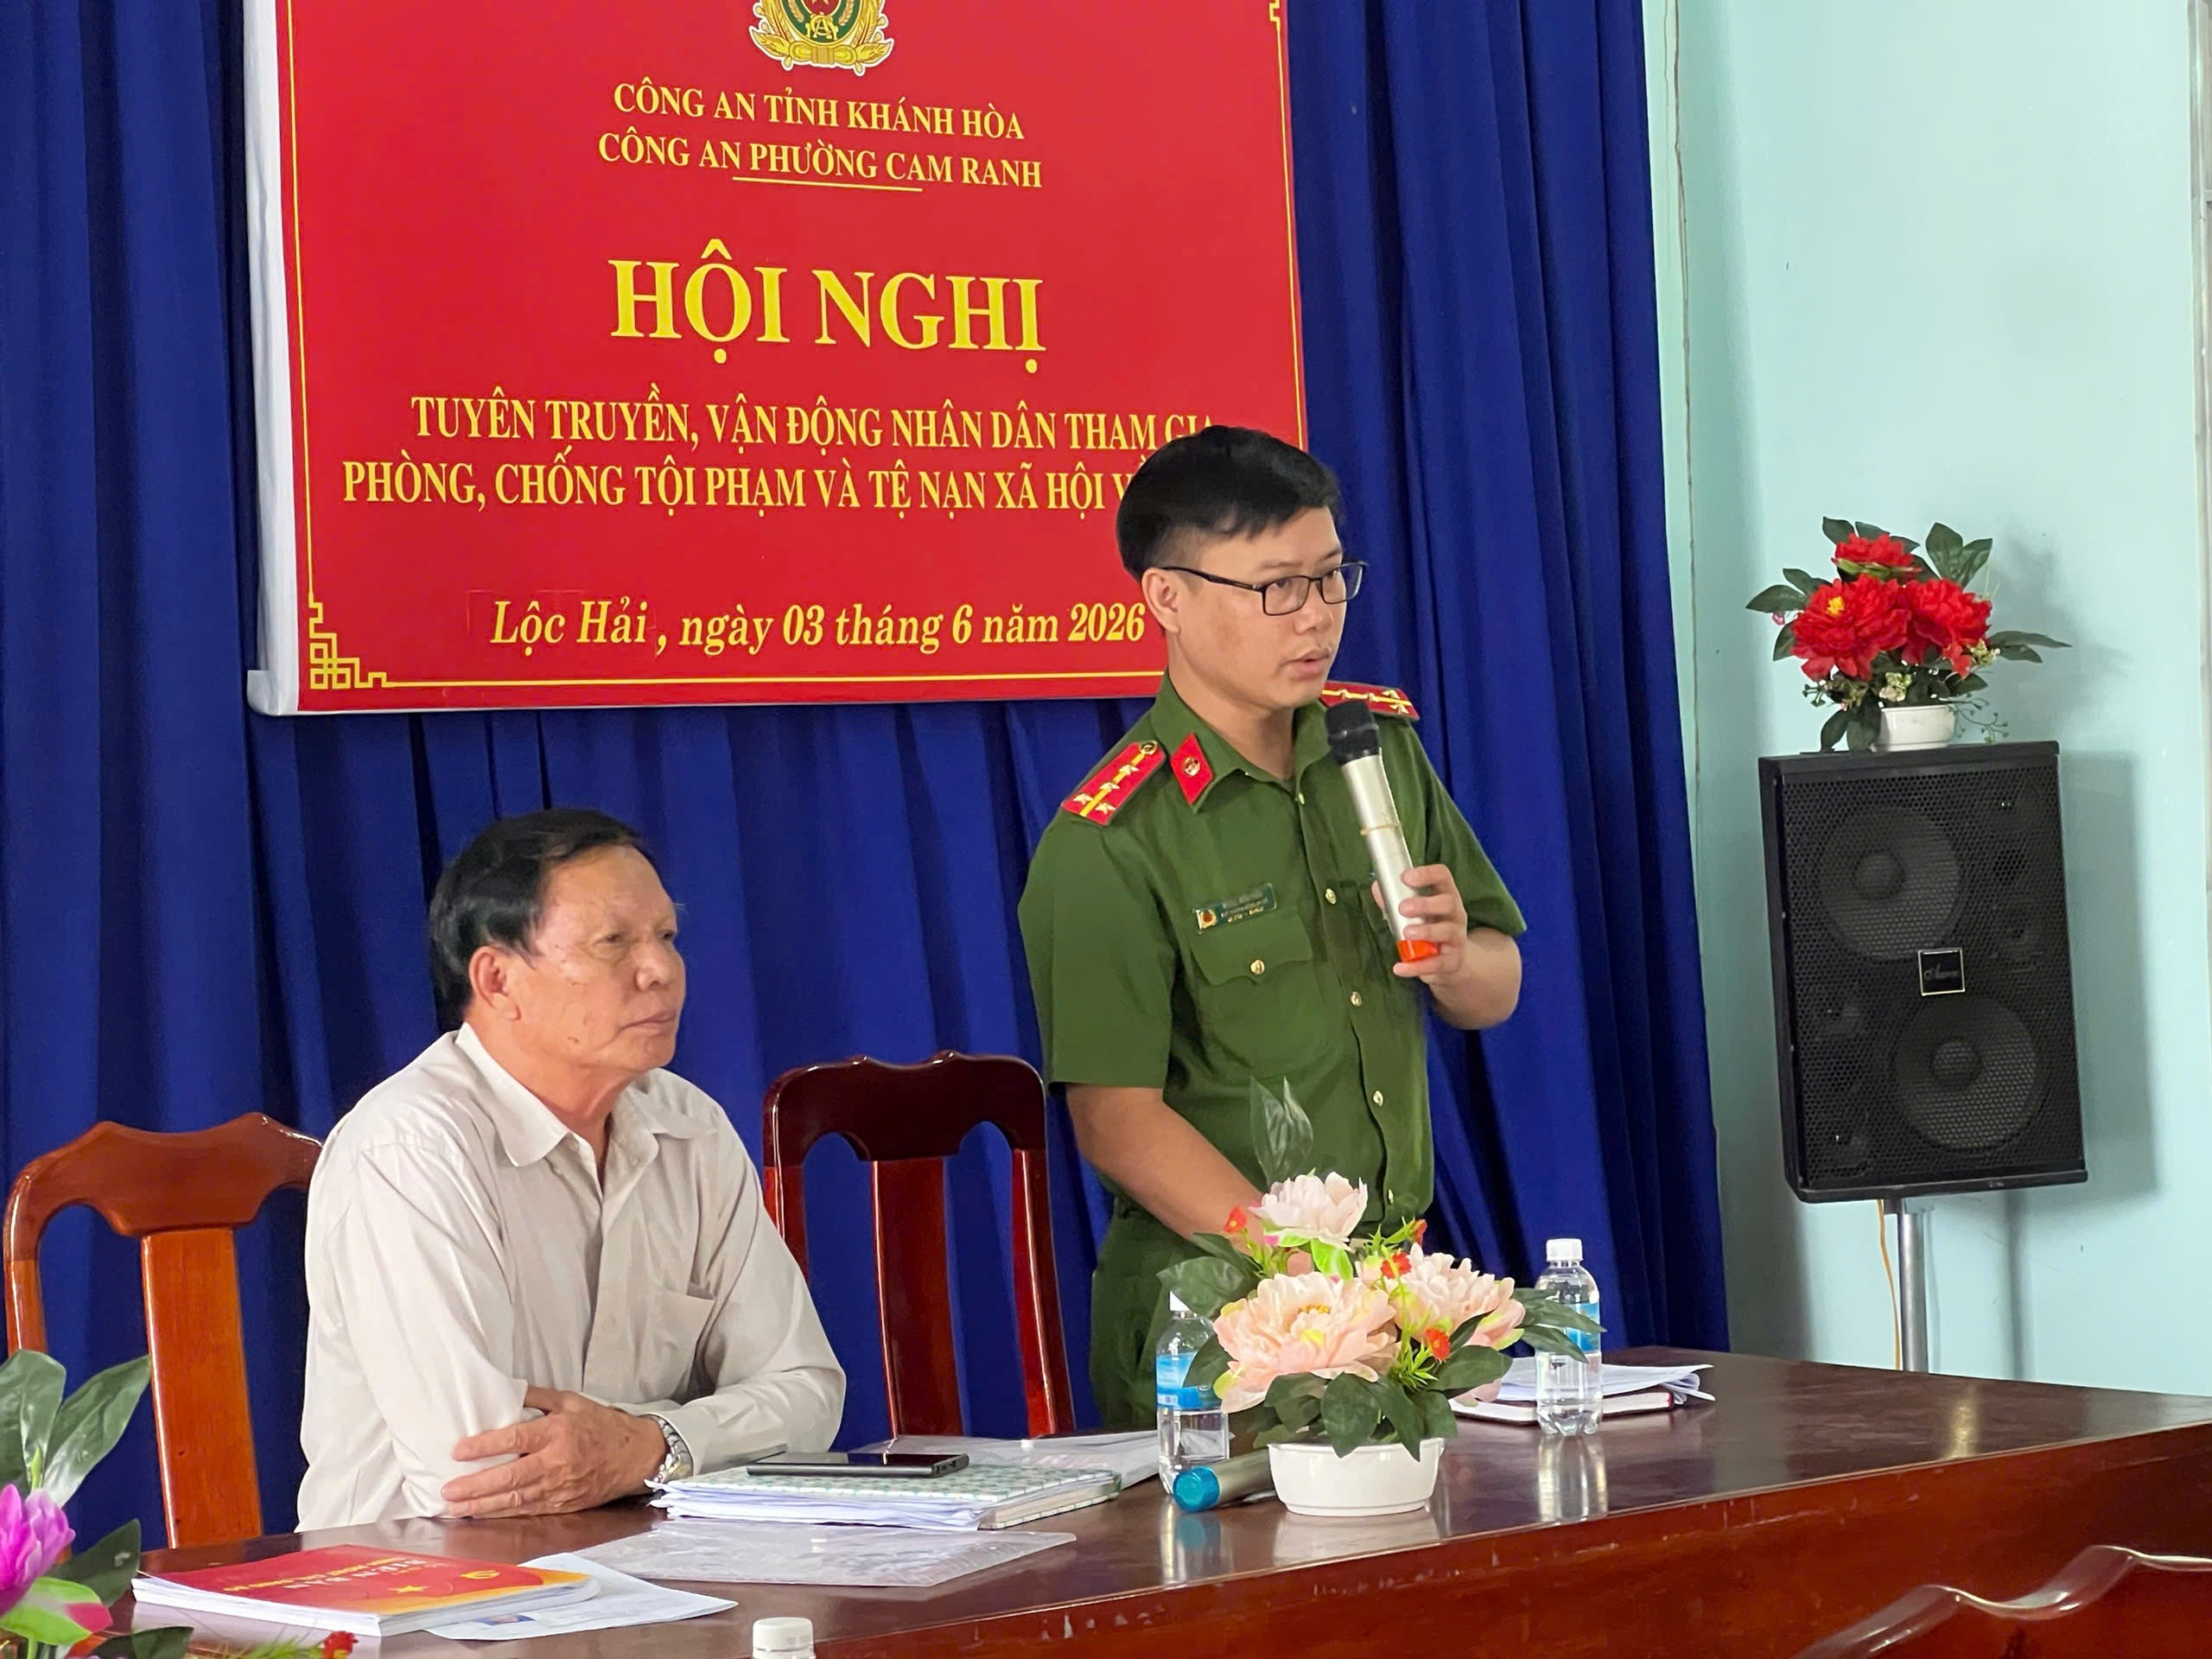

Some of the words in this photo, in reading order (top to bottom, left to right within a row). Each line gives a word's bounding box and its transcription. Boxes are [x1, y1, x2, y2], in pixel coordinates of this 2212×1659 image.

[613, 76, 705, 118] CÔNG
[713, 91, 756, 123] AN
[763, 86, 839, 127] TỈNH
[847, 96, 955, 135] KHÁNH
[961, 102, 1026, 140] HÒA
[598, 125, 690, 167] CÔNG
[698, 139, 741, 169] AN
[749, 138, 878, 179] PHƯỜNG
[886, 152, 953, 183] CAM
[960, 156, 1043, 188] RANH
[607, 238, 791, 364] HỘI
[811, 269, 1047, 374] NGHỊ
[410, 385, 536, 440] TUYÊN
[544, 382, 699, 450] TRUYỀN,
[705, 392, 778, 454] VẬN
[785, 395, 883, 456] ĐỘNG
[891, 398, 982, 448] NHÂN
[990, 399, 1056, 449] DÂN
[1064, 413, 1158, 451] THAM
[342, 448, 486, 512] PHÒNG,
[495, 444, 626, 505] CHỐNG
[634, 454, 697, 517] TỘI
[704, 467, 806, 518] PHẠM
[813, 457, 861, 508] VÀ
[868, 458, 912, 519] TỆ
[918, 471, 986, 519] NẠN
[994, 461, 1039, 509] XÃ
[1046, 461, 1106, 520] HỘI
[490, 601, 566, 657] Lộc
[678, 603, 775, 656] ngày
[782, 604, 825, 645] 03
[836, 603, 944, 655] tháng
[952, 604, 973, 645] 6
[981, 603, 1059, 644] năm
[1067, 602, 1146, 642] 2026
